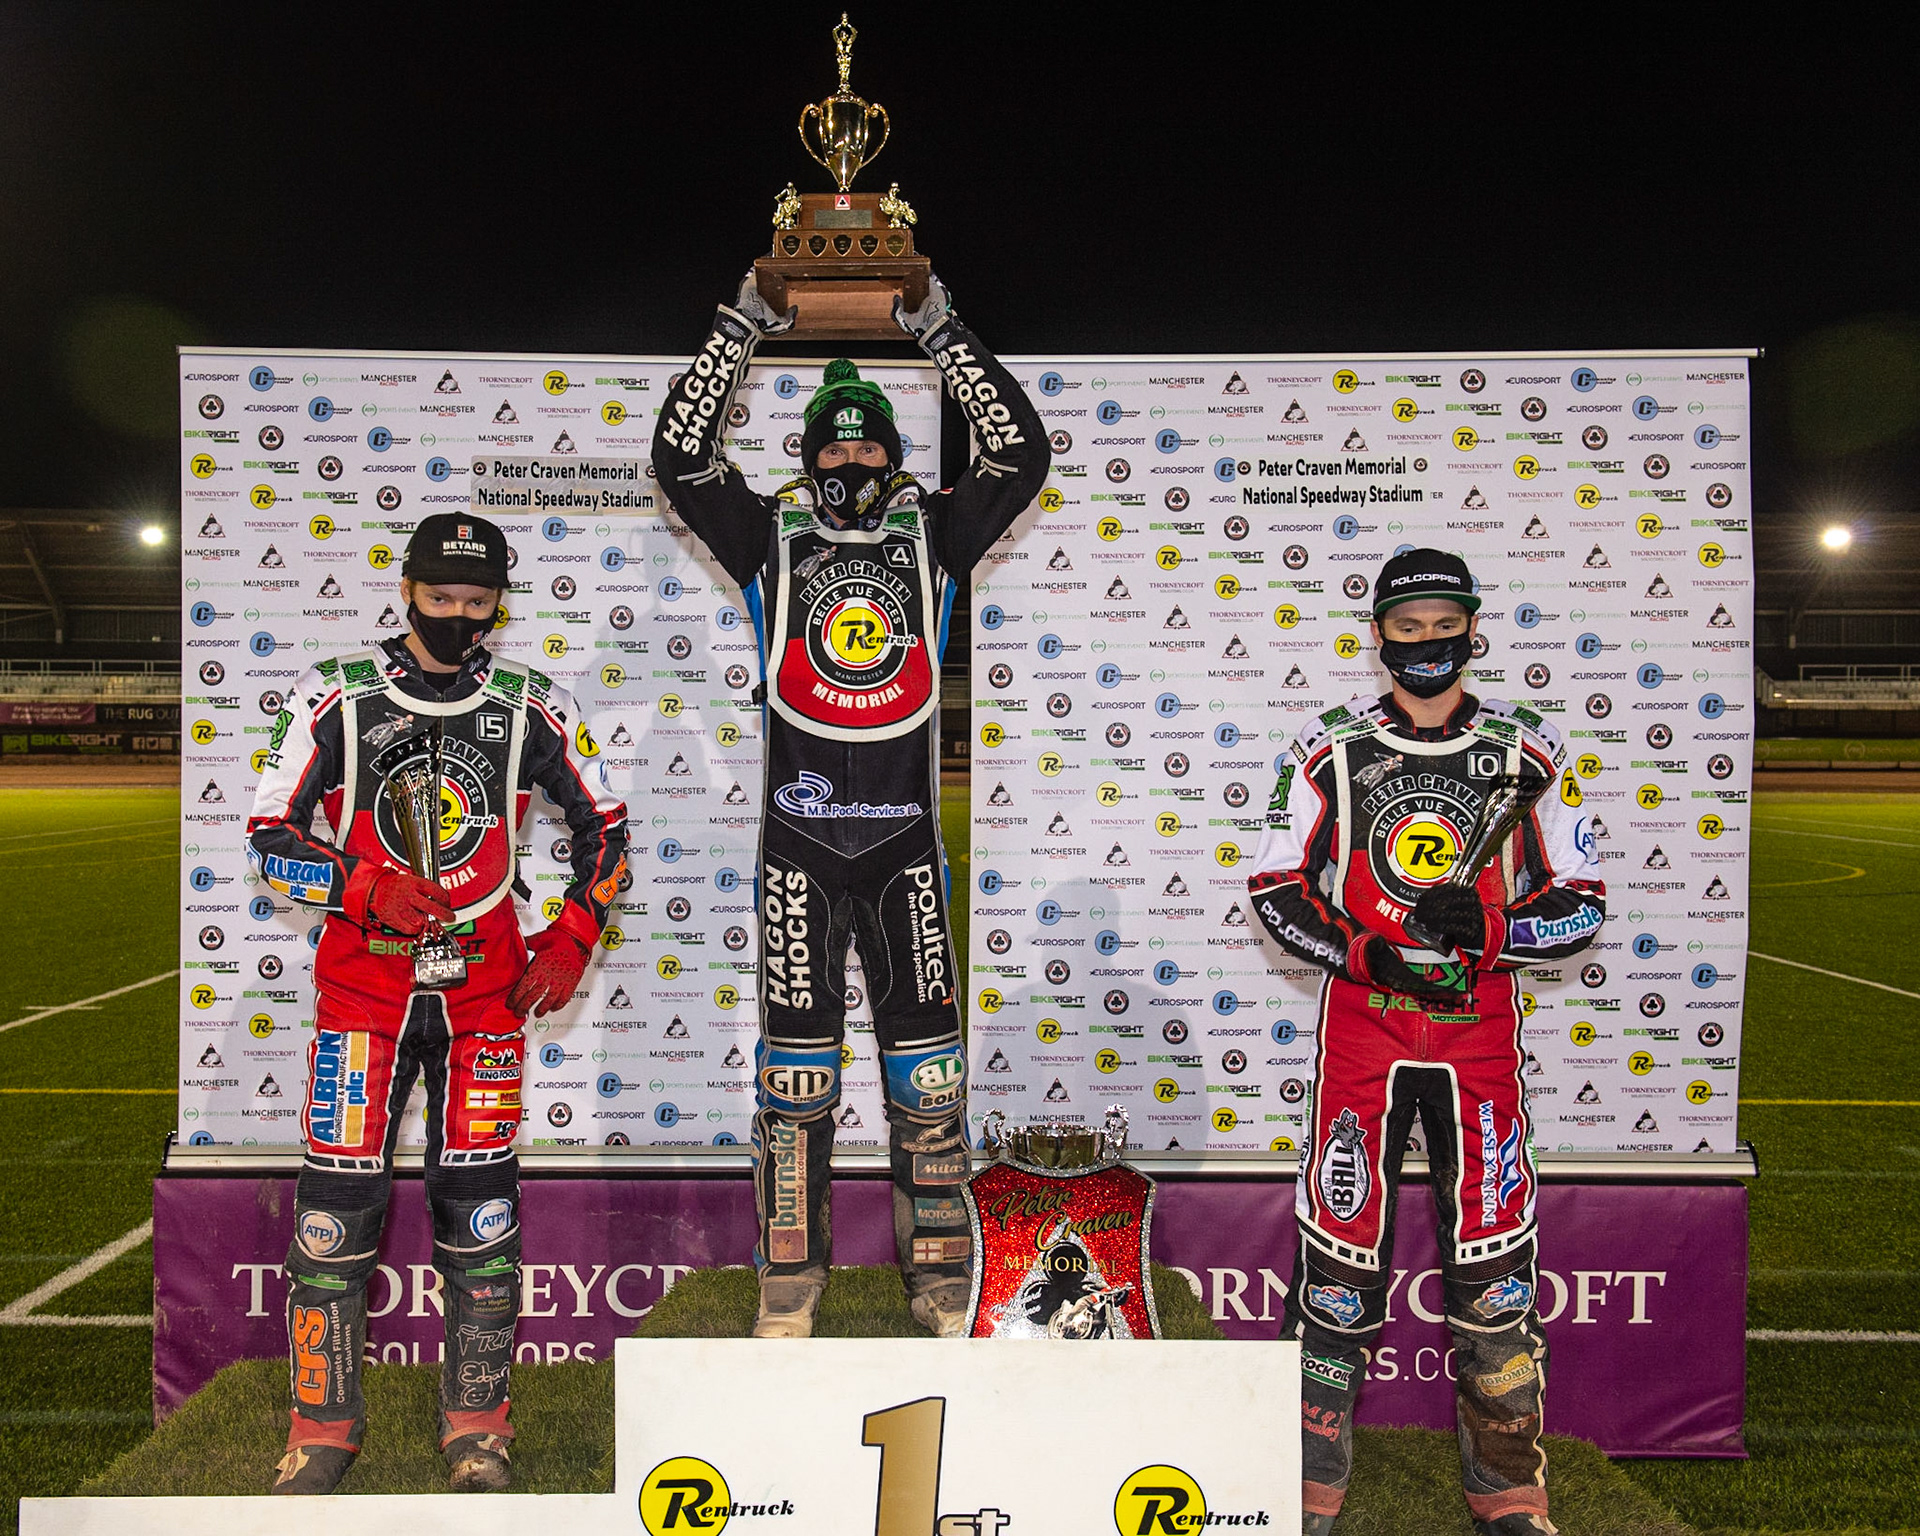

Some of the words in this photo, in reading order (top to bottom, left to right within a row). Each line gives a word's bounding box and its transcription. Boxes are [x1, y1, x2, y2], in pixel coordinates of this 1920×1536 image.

[362, 374, 416, 382] MANCHESTER
[595, 378, 650, 386] BIKERIGHT
[662, 330, 726, 448] HAGON
[682, 340, 742, 456] SHOCKS
[936, 350, 1003, 453] SHOCKS
[948, 342, 1026, 446] HAGON
[184, 430, 239, 438] BIKERIGHT
[837, 430, 864, 439] BOLL
[1506, 432, 1562, 440] BIKERIGHT
[494, 461, 528, 478] Peter
[531, 462, 576, 479] Craven
[579, 462, 638, 480] Memorial
[1259, 459, 1292, 477] Peter
[1296, 458, 1341, 476] Craven
[1345, 457, 1406, 475] Memorial
[478, 489, 531, 507] National
[535, 490, 598, 511] Speedway
[602, 490, 653, 508] Stadium
[1243, 486, 1297, 505] National
[1300, 486, 1366, 508] Speedway
[1370, 484, 1423, 502] Stadium
[443, 541, 486, 552] BETARD
[890, 547, 910, 565] 4
[800, 562, 846, 605] PETER
[849, 559, 913, 603] CRAVEN
[1390, 573, 1461, 588] POLCOPPER
[812, 589, 842, 626] BELLE
[847, 585, 873, 597] VUE
[878, 595, 901, 625] ACES
[840, 619, 918, 651] Rentruck
[835, 669, 884, 682] MANCHESTER
[812, 682, 905, 709] MEMORIAL
[128, 708, 154, 719] RUG
[479, 715, 505, 738] 15
[30, 734, 122, 746] BIKERIGHT
[442, 735, 495, 781] RAVEN
[1470, 754, 1499, 777] 10
[1631, 760, 1688, 768] BIKERIGHT
[1150, 788, 1205, 796] BIKERIGHT
[1362, 775, 1416, 815] PETER
[1417, 773, 1483, 815] CRAVE
[807, 804, 831, 817] M.R.
[833, 804, 859, 816] Pool
[861, 804, 905, 817] Services
[1376, 805, 1410, 838] BELLE
[1415, 800, 1445, 813] VUE
[1448, 811, 1471, 837] ACE
[265, 856, 331, 884] ALBON
[290, 885, 307, 898] plc
[907, 891, 917, 910] the
[765, 863, 790, 1008] HAGON
[786, 870, 813, 1011] SHOCKS
[904, 863, 947, 1001] poultec
[909, 910, 921, 951] training
[1208, 938, 1264, 946] MANCHESTER
[184, 962, 239, 970] BIKERIGHT
[913, 951, 927, 1004] specialists
[592, 1021, 647, 1029] MANCHESTER
[1432, 1014, 1479, 1022] MOTORBIKE
[310, 1031, 342, 1144] ALBON
[347, 1070, 367, 1104] plc
[920, 1091, 961, 1109] BOLL
[333, 1096, 343, 1144] ENGINEERING
[1559, 1115, 1615, 1123] MANCHESTER
[920, 1164, 966, 1174] Mitas
[1331, 1144, 1356, 1207] BALL
[917, 1208, 966, 1219] MOTOREX
[989, 1185, 1074, 1231] Peter
[480, 1212, 506, 1229] ATPI
[1034, 1208, 1135, 1252] Craven
[304, 1225, 333, 1241] ATPI
[1003, 1255, 1123, 1275] MEMORIAL
[331, 1302, 342, 1353] Filtration
[345, 1323, 353, 1373] Solutions
[336, 1354, 345, 1403] Complete
[1333, 1370, 1349, 1382] OIL
[1480, 1363, 1531, 1385] AGROMIX
[656, 1478, 795, 1529] Rentruck
[1130, 1486, 1270, 1535] Rentruck
